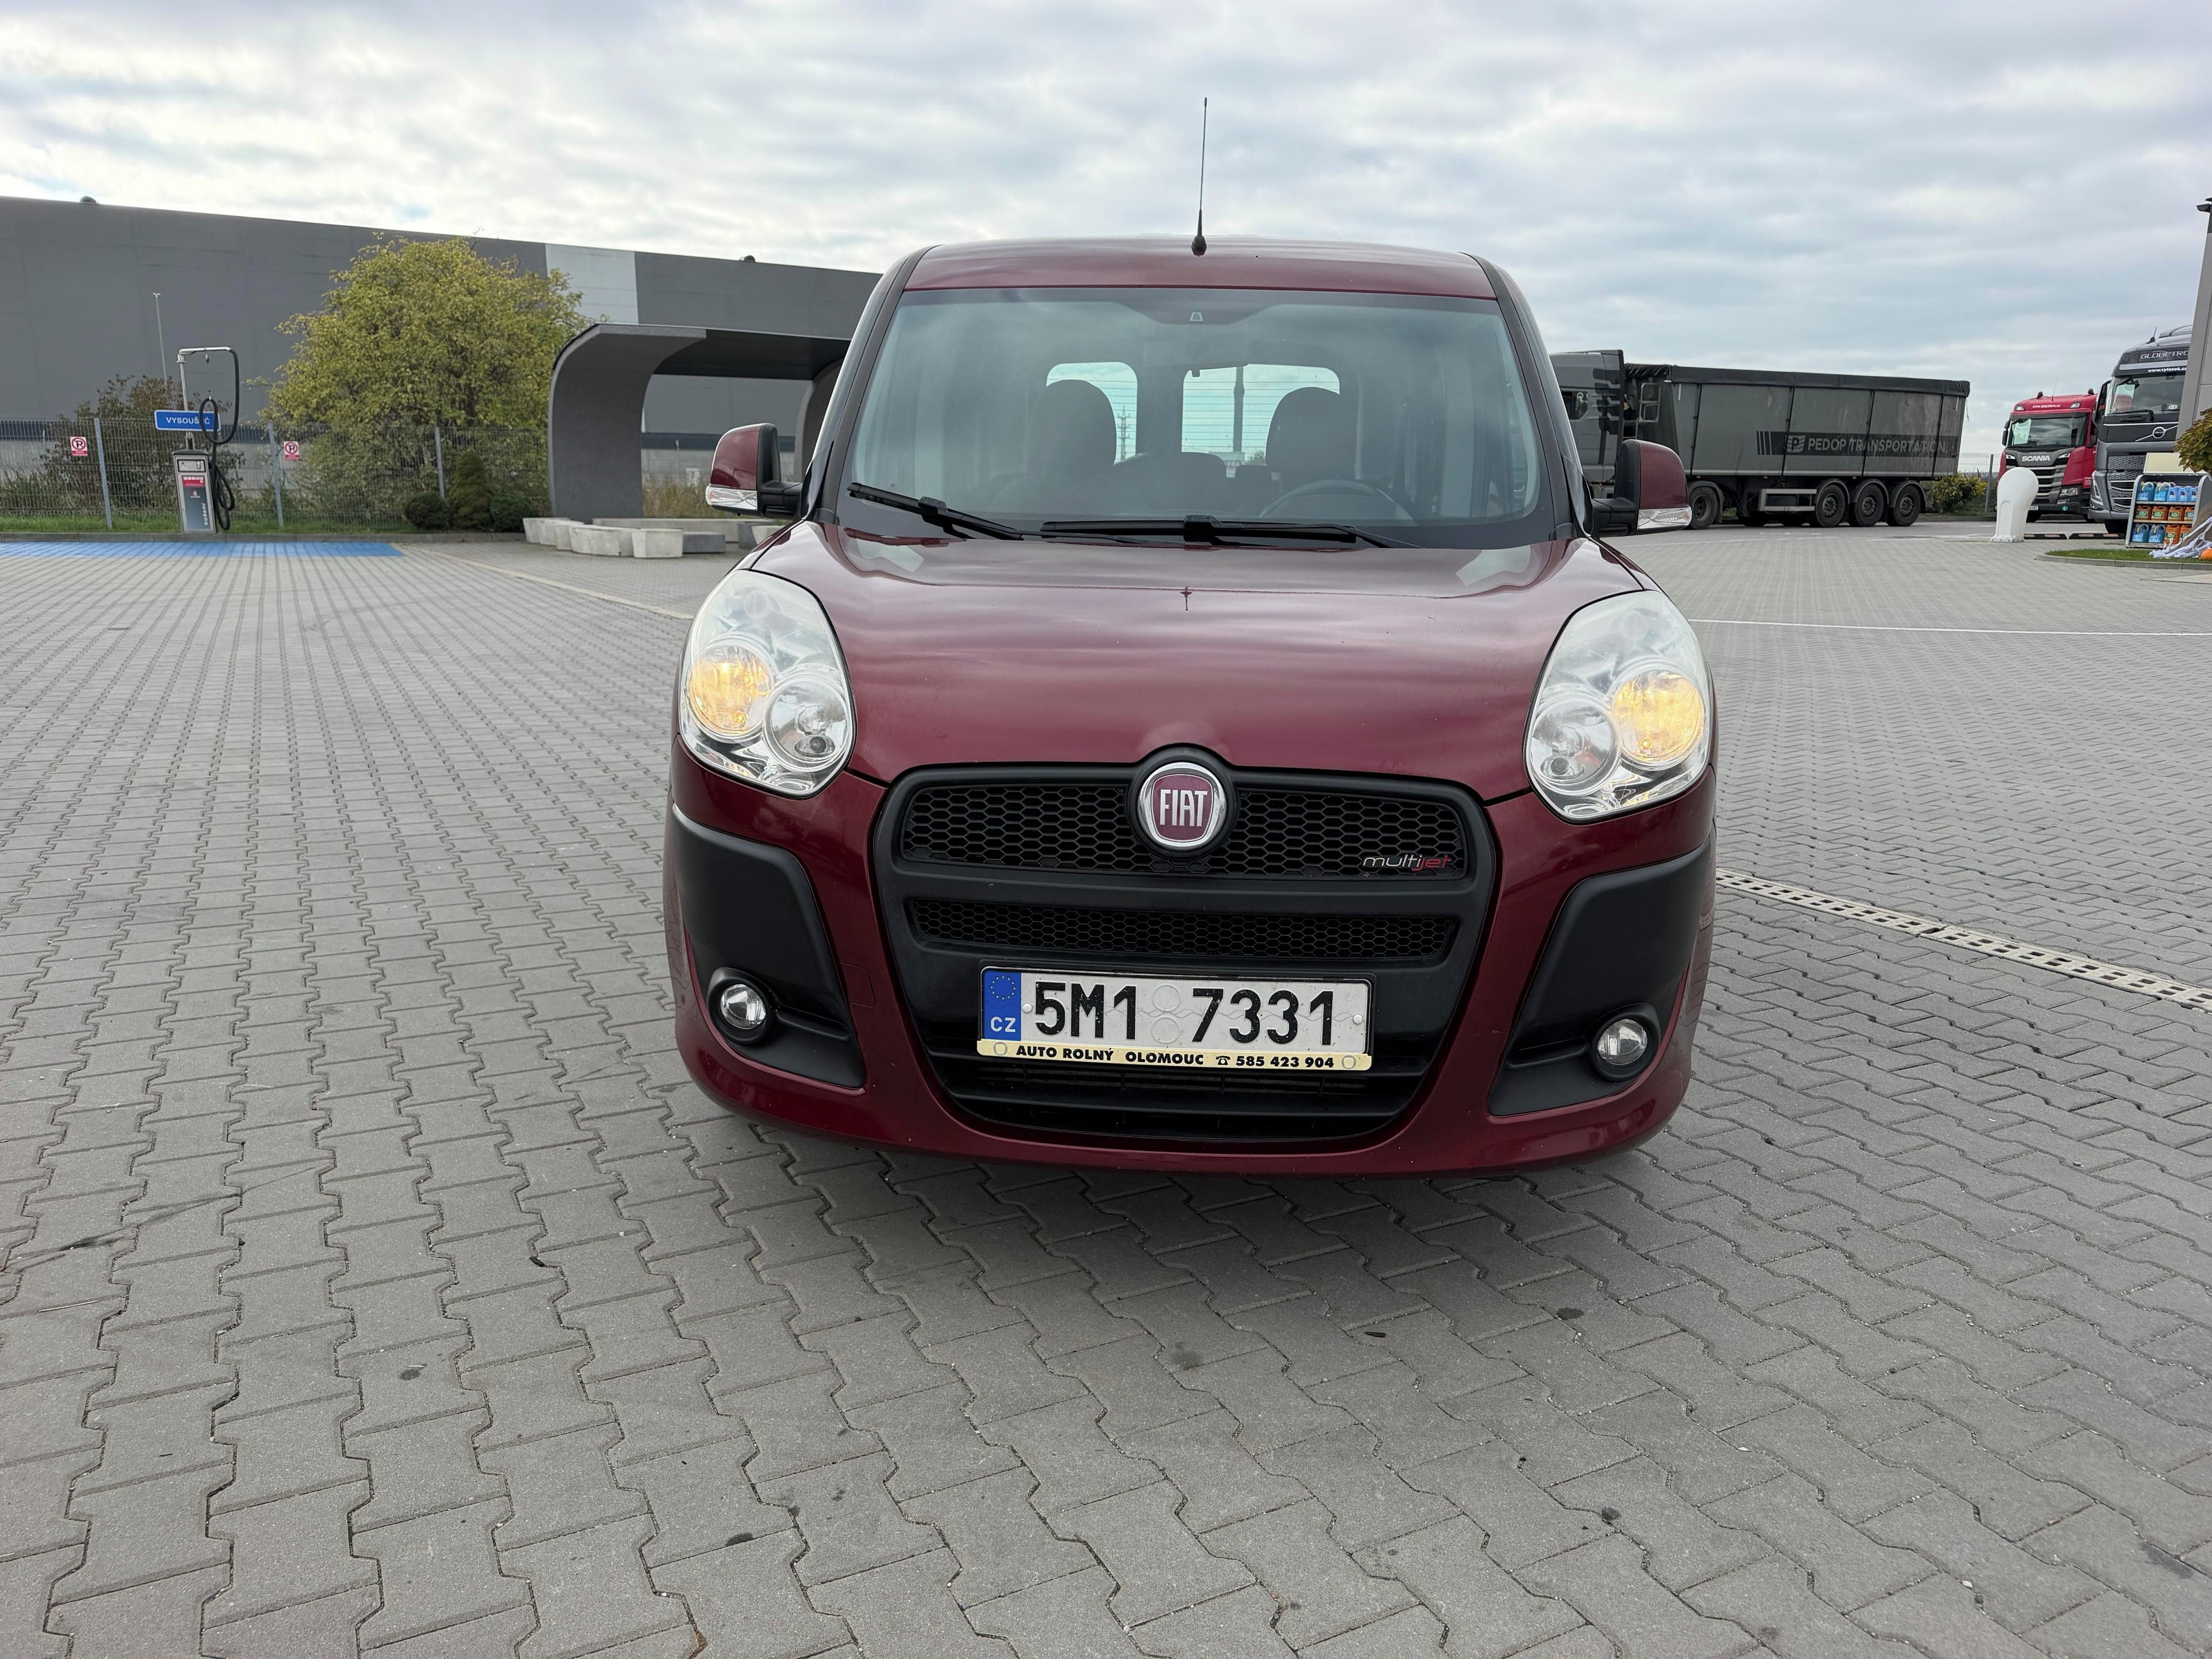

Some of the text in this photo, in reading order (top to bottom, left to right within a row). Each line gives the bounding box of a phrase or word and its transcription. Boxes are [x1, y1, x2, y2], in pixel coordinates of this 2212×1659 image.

[166, 416, 210, 424] VYSOUŠČ
[1808, 438, 1846, 450] PEDOP
[1849, 439, 1945, 453] TRANSPORTATION
[1159, 789, 1208, 827] FIAT
[1363, 854, 1452, 871] multijet
[1035, 981, 1333, 1045] 5M1 7331
[990, 1016, 1016, 1032] CZ
[1016, 1046, 1334, 1068] AUTO ROLNÝ OLOMOUC 585 423 904
